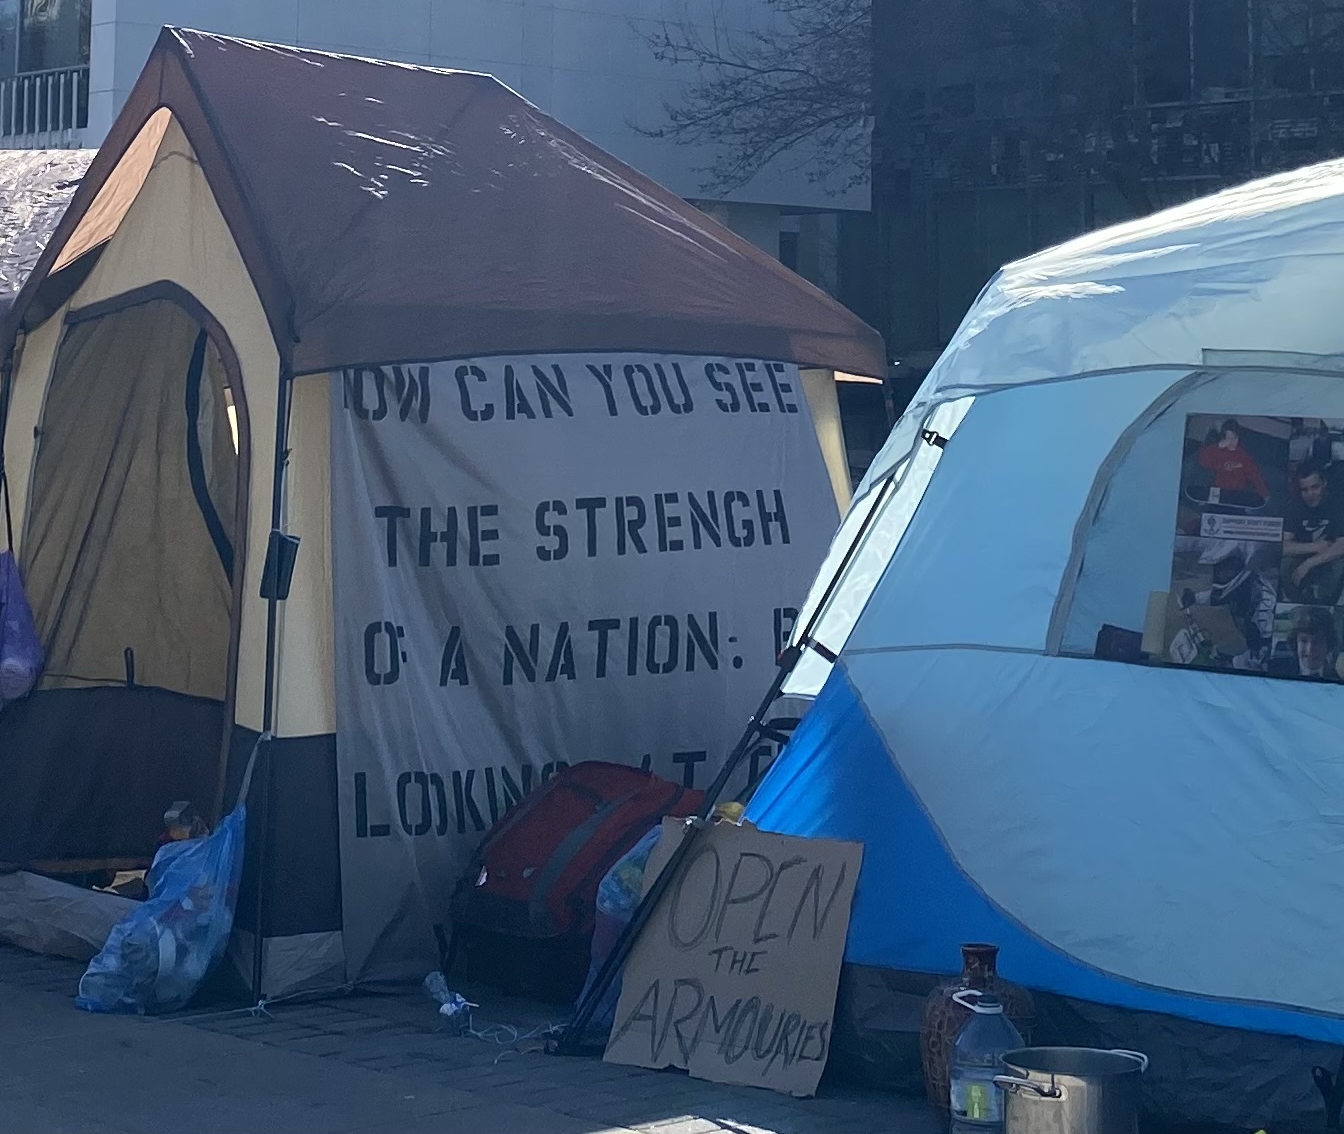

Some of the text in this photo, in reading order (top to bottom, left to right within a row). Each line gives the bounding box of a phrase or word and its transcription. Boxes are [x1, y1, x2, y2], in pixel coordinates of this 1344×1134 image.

[454, 364, 574, 422] CAN
[585, 362, 694, 416] YOU
[704, 362, 799, 414] SEE
[374, 489, 791, 566] THE STRENGH
[363, 621, 408, 686] O
[439, 625, 470, 687] A
[502, 611, 744, 686] NATION:
[667, 842, 848, 952] OPEN
[707, 945, 768, 976] THE
[605, 978, 830, 1077] ARMOURIES
